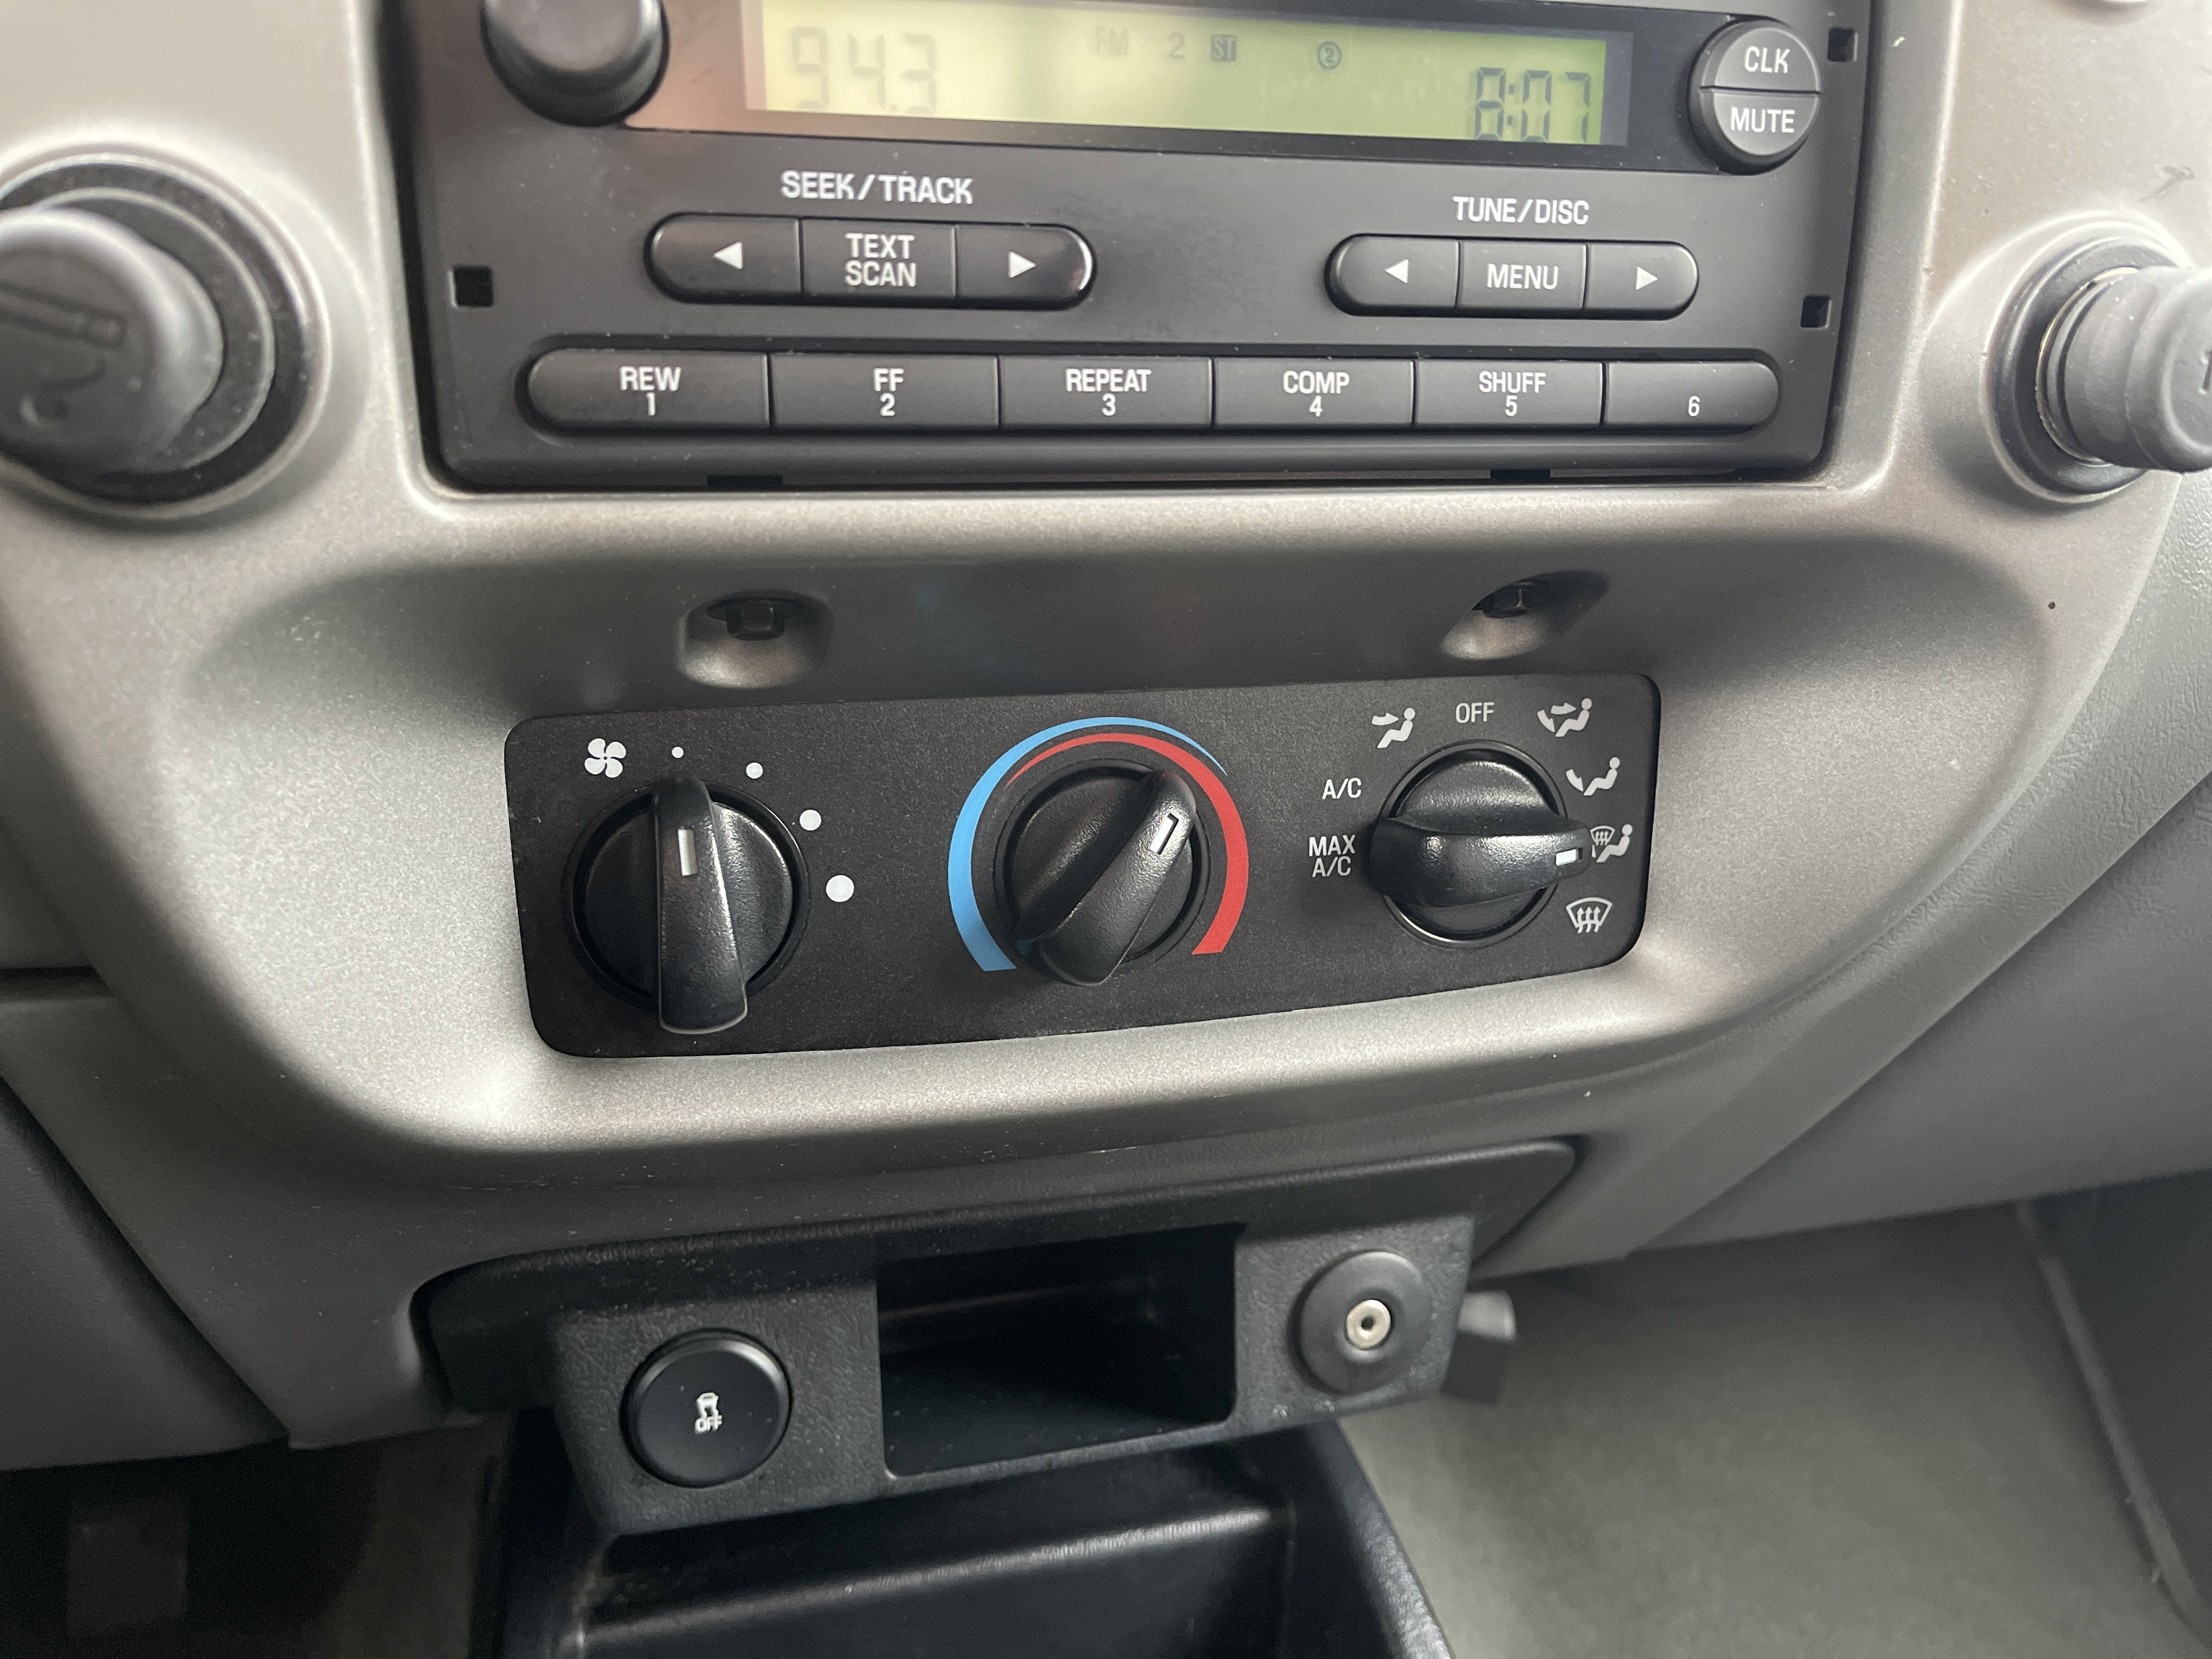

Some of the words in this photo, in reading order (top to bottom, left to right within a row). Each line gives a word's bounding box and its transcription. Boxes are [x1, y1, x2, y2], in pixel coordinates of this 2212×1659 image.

[1096, 27, 1129, 57] FM
[1168, 32, 1187, 59] 2
[1744, 45, 1791, 74] CLK
[1475, 66, 1591, 143] 8:07
[1730, 106, 1795, 133] MUTE
[781, 169, 973, 205] SEEK/TRACK
[1452, 196, 1589, 225] TUNE/DISC
[844, 233, 915, 259] TEXT
[845, 259, 917, 287] SCAN
[1487, 263, 1559, 290] MENU
[619, 365, 681, 392] REW
[873, 368, 905, 392] FF
[1065, 368, 1152, 392] REPEAT
[1283, 370, 1350, 394] COMP
[1479, 371, 1547, 393] SHUFF
[645, 392, 656, 416] 1
[879, 392, 896, 417] 2
[1101, 393, 1116, 416] 3
[1309, 396, 1323, 417] 4
[1505, 396, 1518, 417] 5
[1688, 396, 1700, 417] 6
[1455, 702, 1495, 723] OFF
[1322, 778, 1362, 800] A/C
[1308, 835, 1356, 856] MAX
[1312, 856, 1352, 878] A/C
